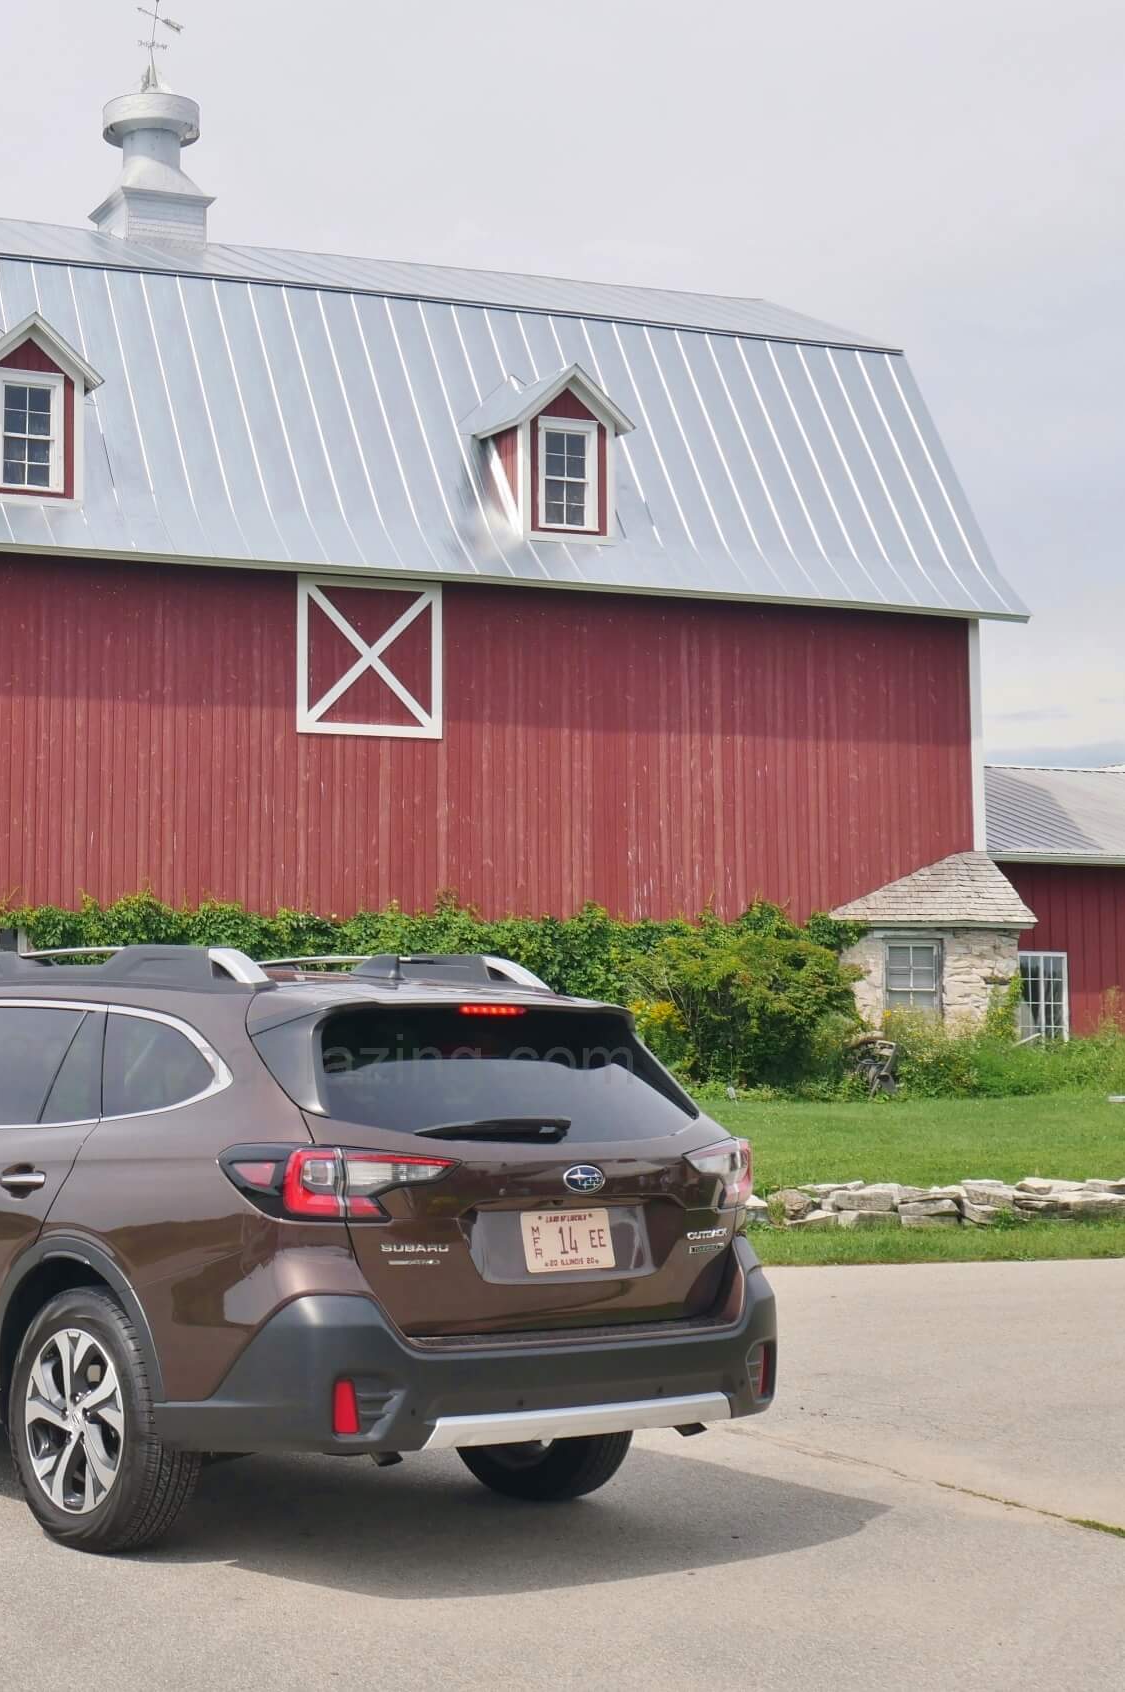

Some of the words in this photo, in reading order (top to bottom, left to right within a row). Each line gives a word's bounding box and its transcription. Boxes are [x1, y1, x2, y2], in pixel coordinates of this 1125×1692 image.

[380, 1244, 449, 1252] SUBARU
[558, 1226, 578, 1255] 14
[589, 1229, 607, 1249] EE
